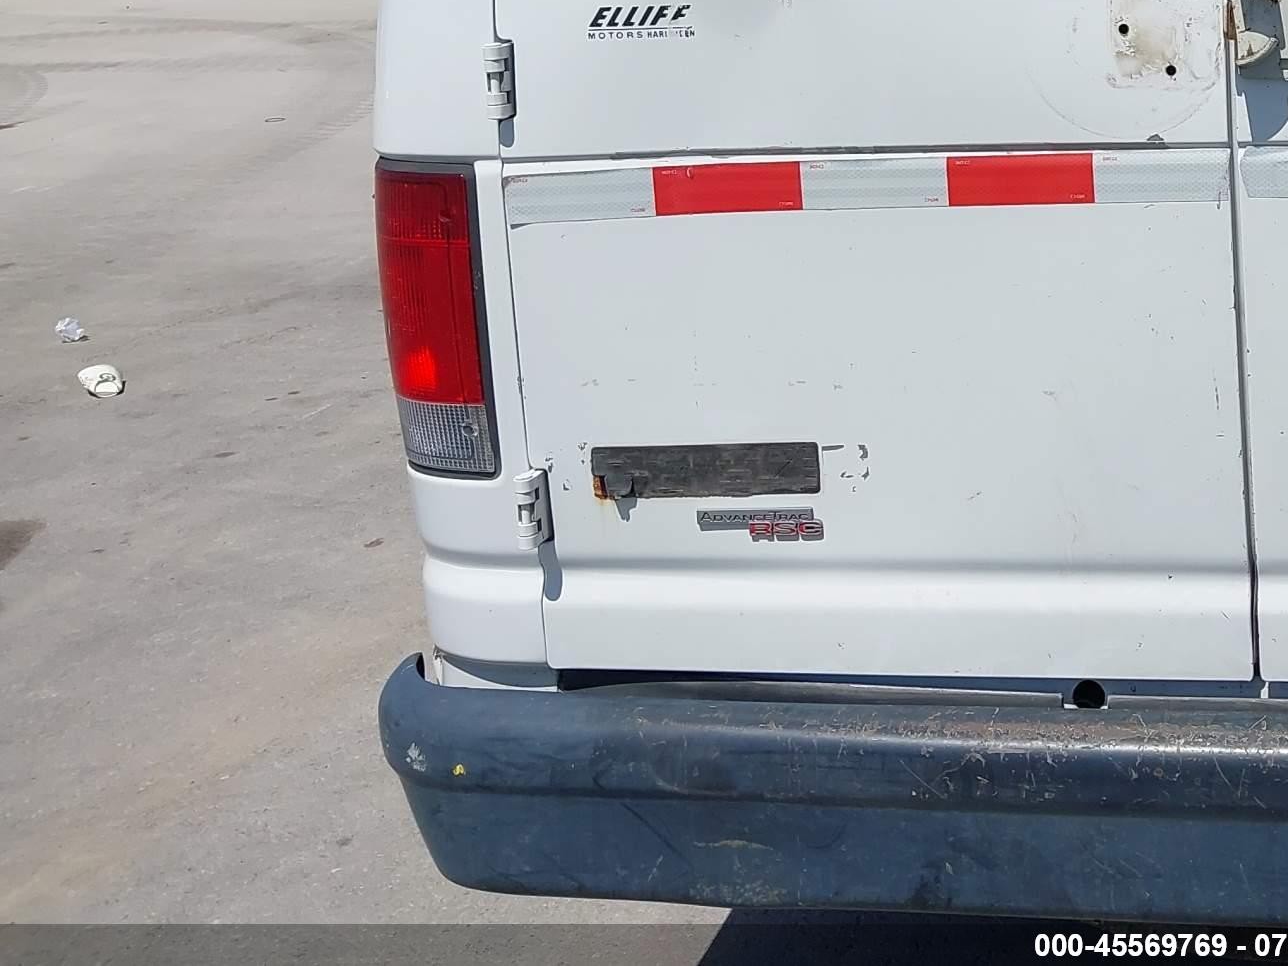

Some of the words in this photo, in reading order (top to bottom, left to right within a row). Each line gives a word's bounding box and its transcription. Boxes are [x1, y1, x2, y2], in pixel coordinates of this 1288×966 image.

[589, 4, 692, 27] ELLIFF
[587, 31, 644, 40] MOTORS
[749, 521, 823, 536] RSC
